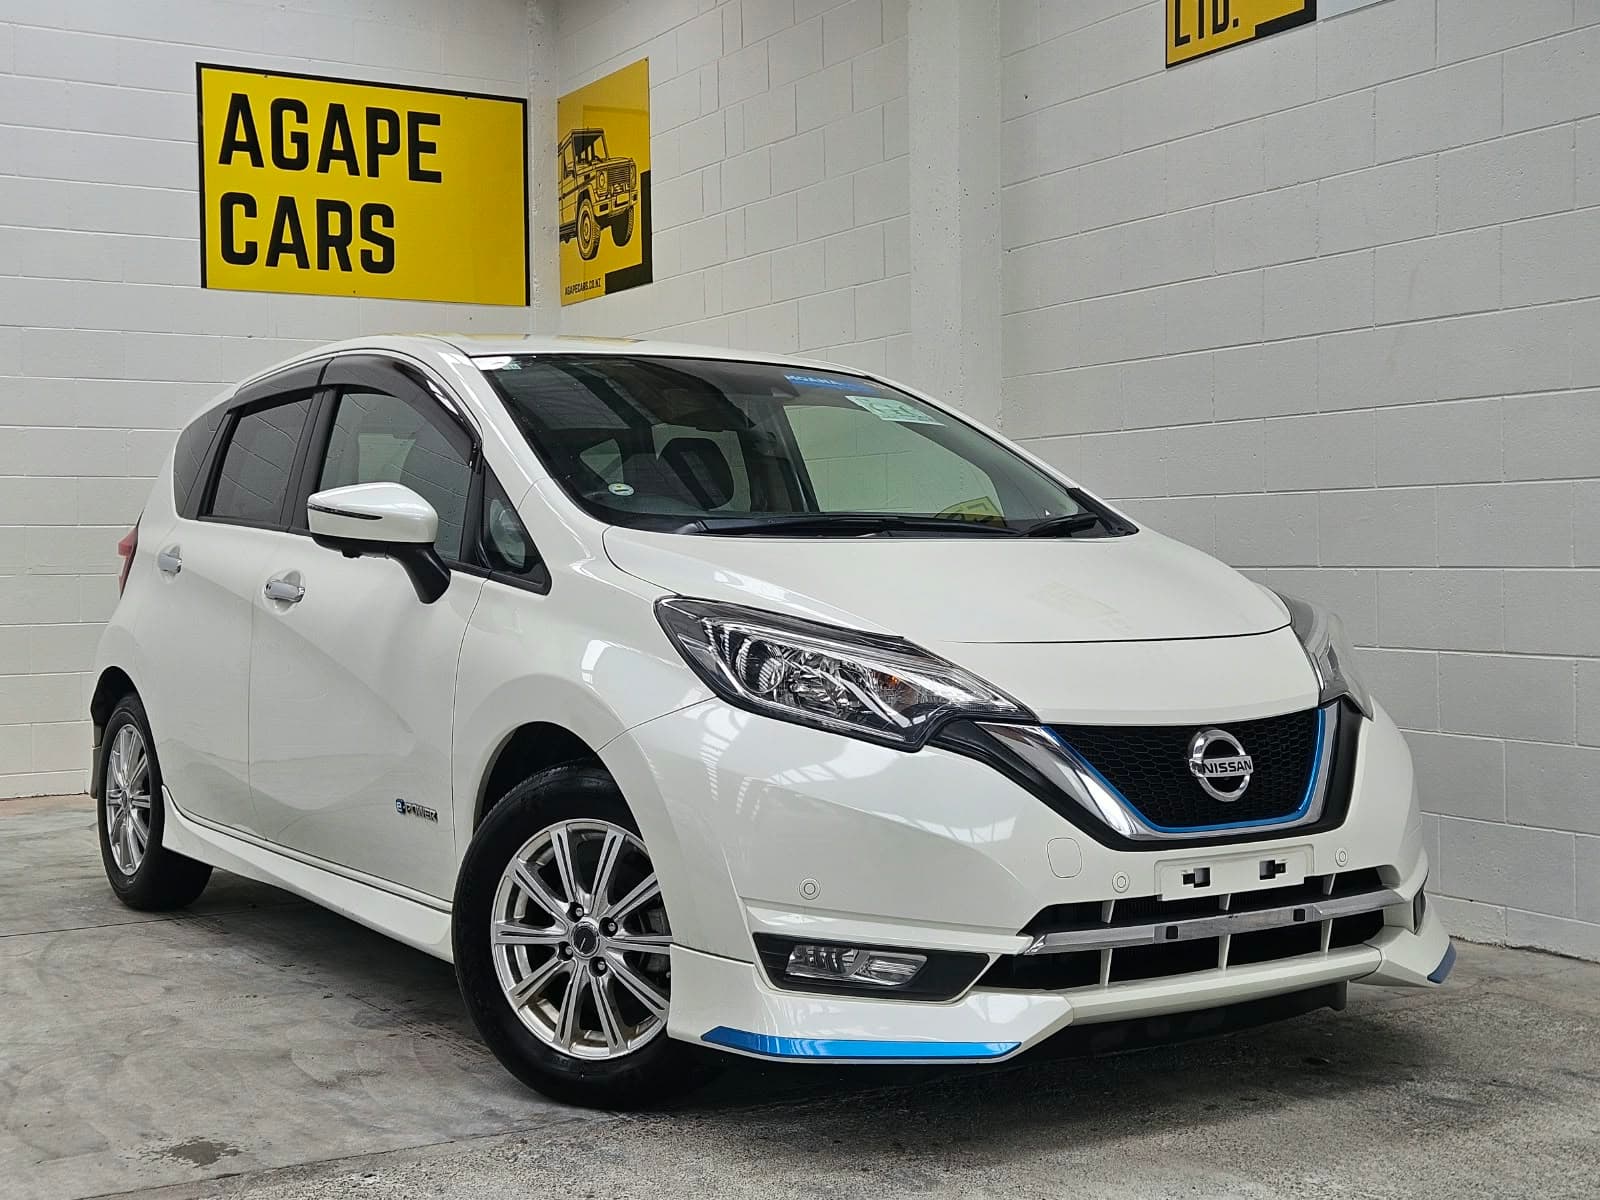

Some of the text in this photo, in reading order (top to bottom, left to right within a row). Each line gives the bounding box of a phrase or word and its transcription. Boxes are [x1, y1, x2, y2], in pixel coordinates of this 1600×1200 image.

[218, 93, 442, 184] AGAPE
[220, 191, 395, 274] CARS
[564, 278, 602, 295] AGAPECARS.CO.NZ
[1202, 760, 1252, 774] NISSAN
